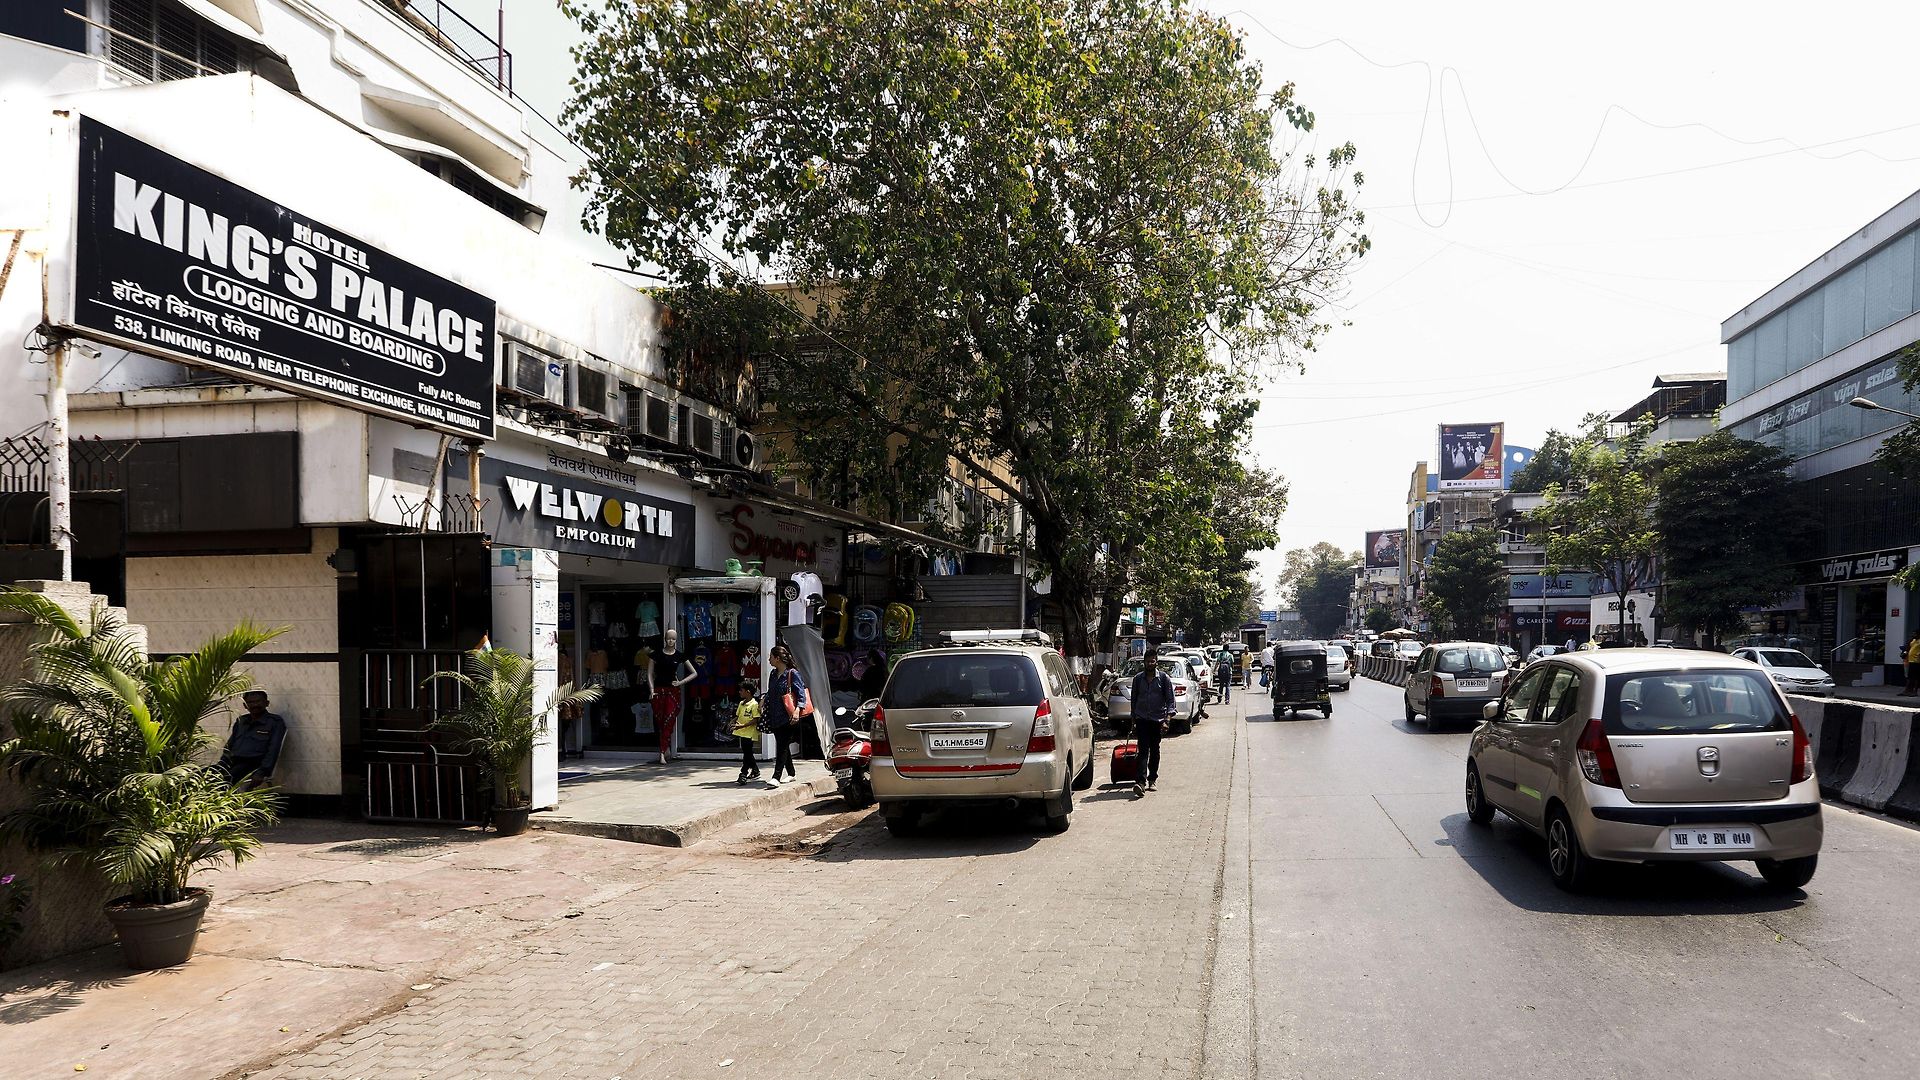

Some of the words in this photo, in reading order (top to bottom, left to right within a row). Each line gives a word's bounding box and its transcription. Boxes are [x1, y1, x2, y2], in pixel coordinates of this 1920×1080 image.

[293, 222, 370, 269] HOTEL
[113, 172, 318, 300] KING'S
[331, 262, 484, 363] PALACE
[112, 279, 163, 310] हॉटेल
[202, 274, 300, 325] LODGING
[304, 312, 344, 339] AND
[349, 327, 434, 369] BOARDING
[114, 314, 147, 339] 538,
[151, 325, 212, 355] LINKING
[215, 344, 255, 369] ROAD,
[258, 357, 291, 377] NEAR
[295, 367, 359, 396] TELEPHONE
[361, 387, 416, 414] EXCHANGE,
[418, 403, 445, 422] KHAR,
[447, 411, 480, 430] MUMBAI
[418, 382, 439, 401] Fully
[440, 389, 454, 402] A/C
[455, 393, 482, 410] Rooms
[505, 475, 673, 537] WELWORTH
[556, 525, 636, 549] EMPORIUM
[1821, 560, 1853, 581] vijay
[1855, 553, 1898, 575] sales
[1544, 580, 1573, 589] SALE
[1675, 833, 1689, 845] MH
[1697, 833, 1708, 845] 02
